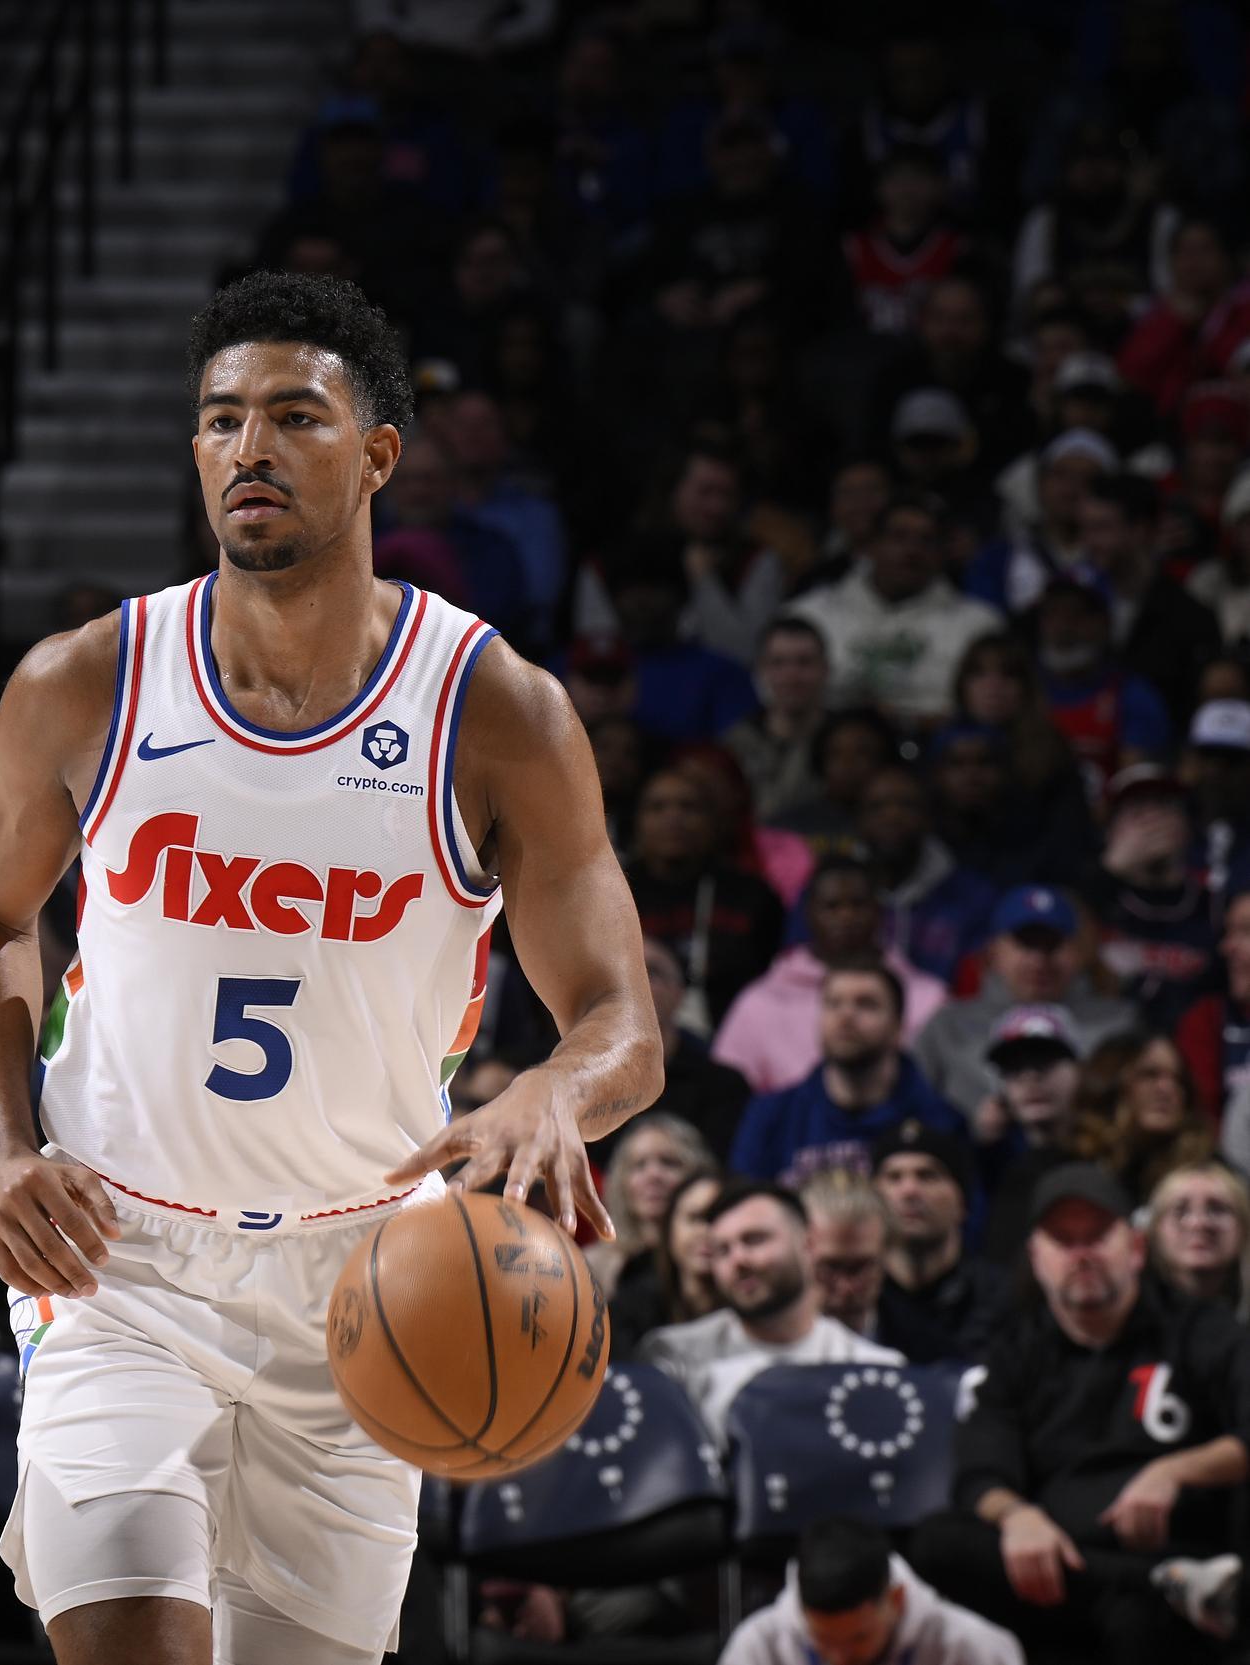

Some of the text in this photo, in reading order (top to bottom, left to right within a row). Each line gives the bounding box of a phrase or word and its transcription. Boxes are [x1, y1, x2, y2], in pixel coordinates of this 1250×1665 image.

[337, 776, 424, 796] crypto.com
[105, 812, 425, 943] Sixers
[204, 977, 302, 1102] 5
